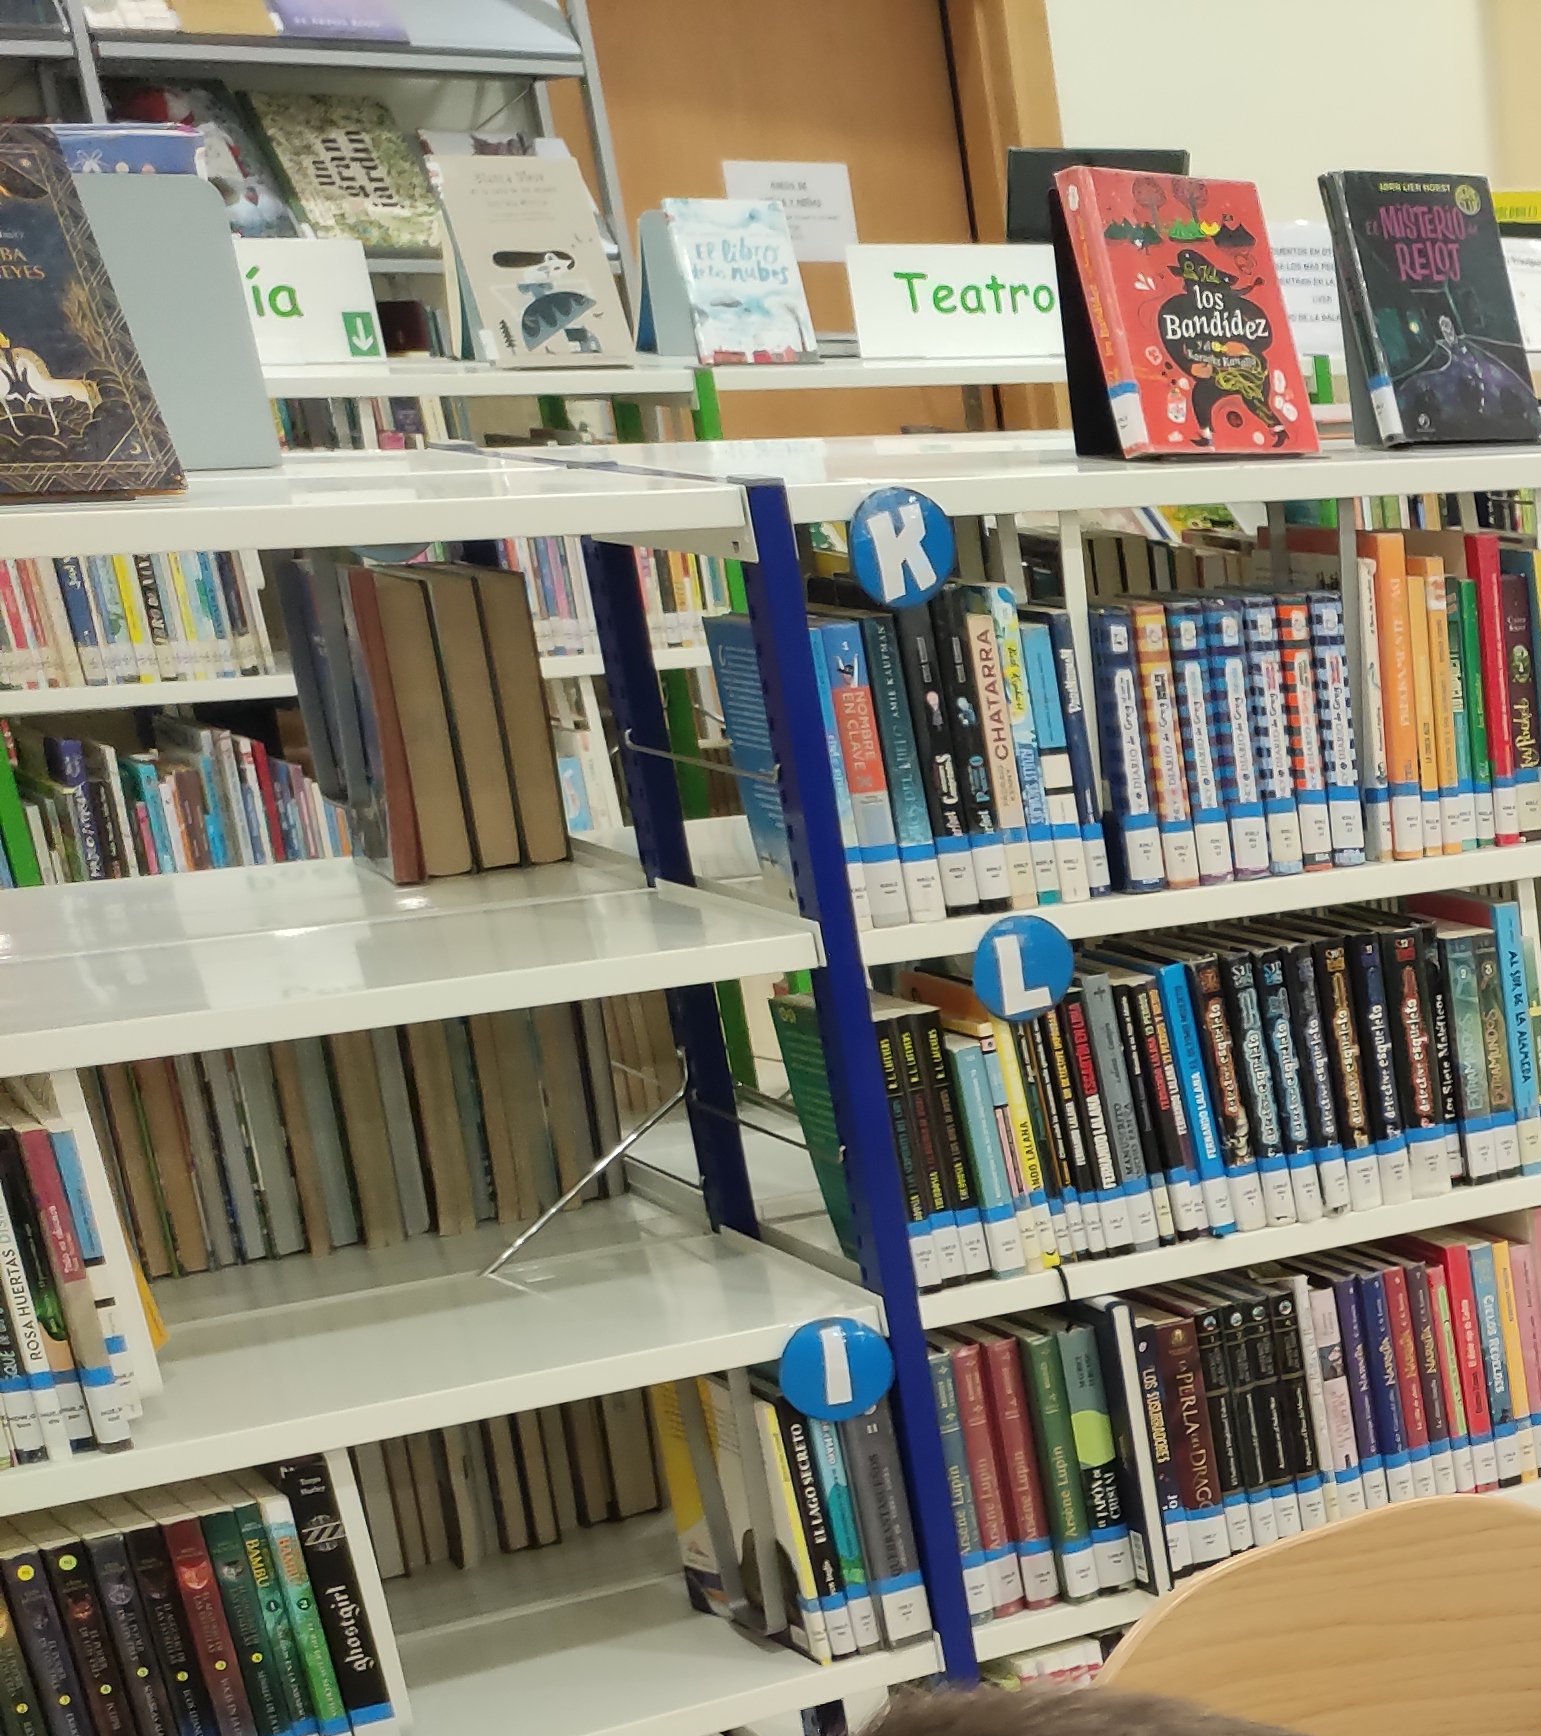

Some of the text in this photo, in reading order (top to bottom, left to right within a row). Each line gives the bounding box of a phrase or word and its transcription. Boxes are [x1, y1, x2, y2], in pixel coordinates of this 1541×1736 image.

[1395, 239, 1462, 282] RELOJ
[892, 270, 1056, 316] Teatro
[1193, 284, 1225, 311] los
[866, 503, 938, 603] K
[855, 691, 876, 760] NOMBRE
[977, 629, 1008, 760] CHATARRA
[1159, 703, 1170, 728] Greg
[842, 692, 866, 771] EN CLAVE
[1124, 705, 1145, 789] DIARIO Greg
[993, 934, 1053, 1016] L
[1369, 1005, 1392, 1068] esqueleto
[8, 1246, 43, 1362] ROSA HUERTAS
[1176, 1372, 1200, 1435] PERLA
[790, 1423, 815, 1486] SECRETO
[948, 1465, 966, 1506] Lupin
[976, 1458, 992, 1502] Lupin
[1015, 1450, 1031, 1495] Lupin
[1053, 1445, 1071, 1488] Lupin
